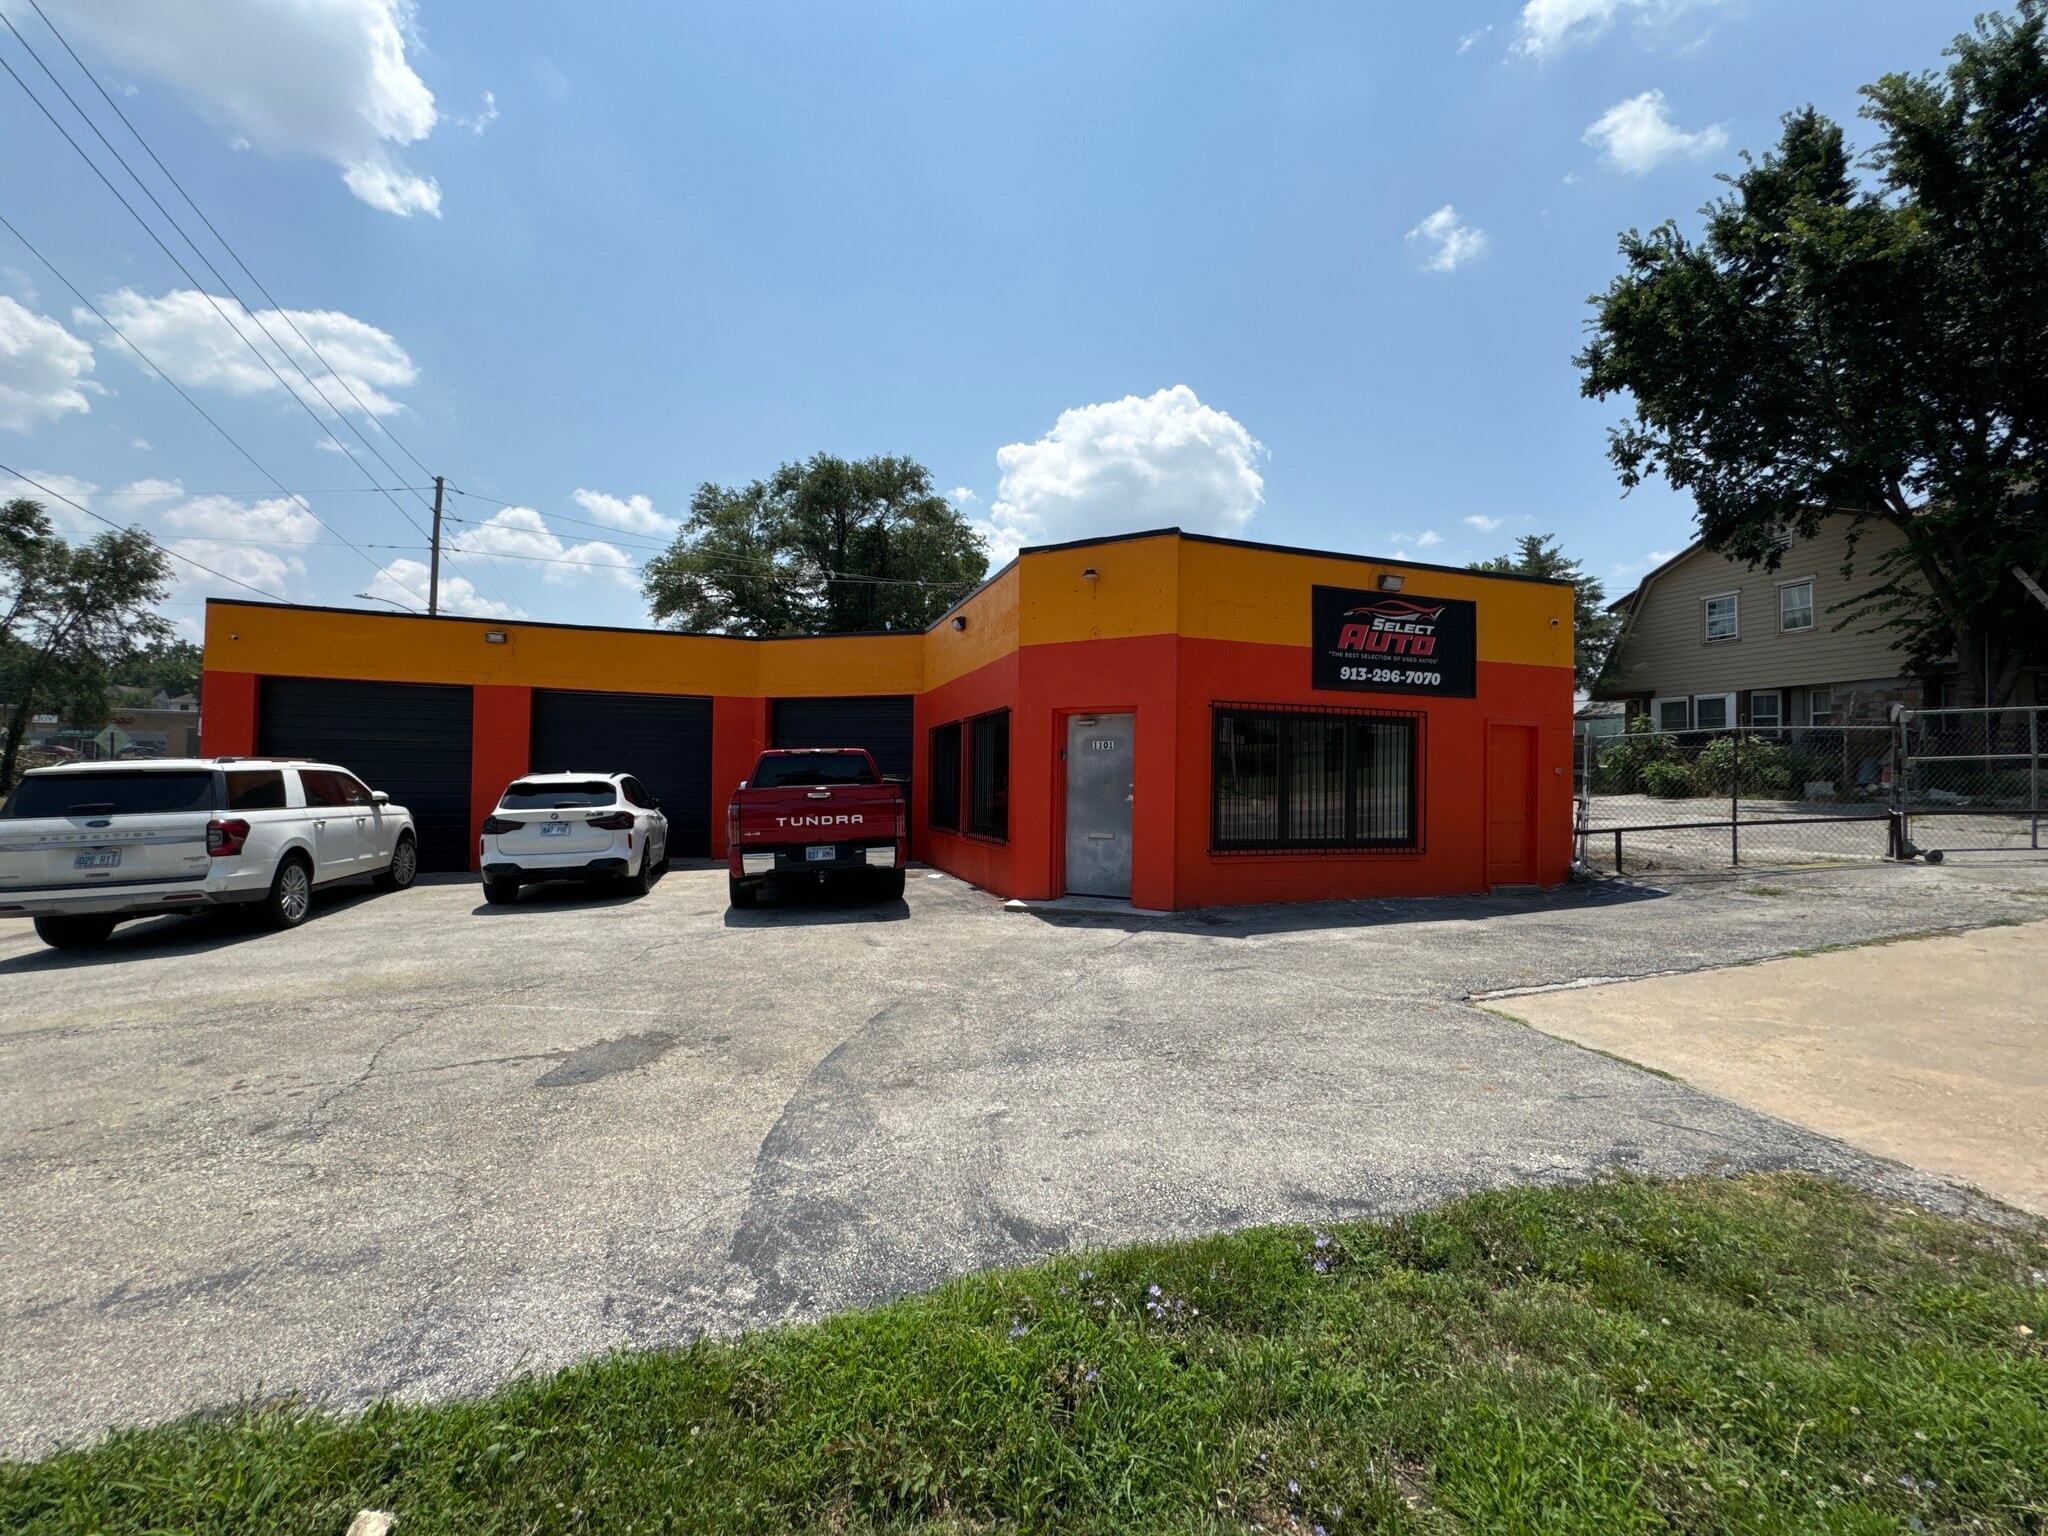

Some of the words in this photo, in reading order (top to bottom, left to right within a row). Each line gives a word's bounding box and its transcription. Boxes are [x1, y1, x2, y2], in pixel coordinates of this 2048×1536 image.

[1371, 617, 1435, 635] SELECT
[1337, 624, 1436, 656] AUTO
[1361, 653, 1392, 661] SELECTION
[1340, 666, 1441, 686] 913-296-7070
[1094, 741, 1113, 749] 1101
[776, 814, 864, 827] TUNDRA
